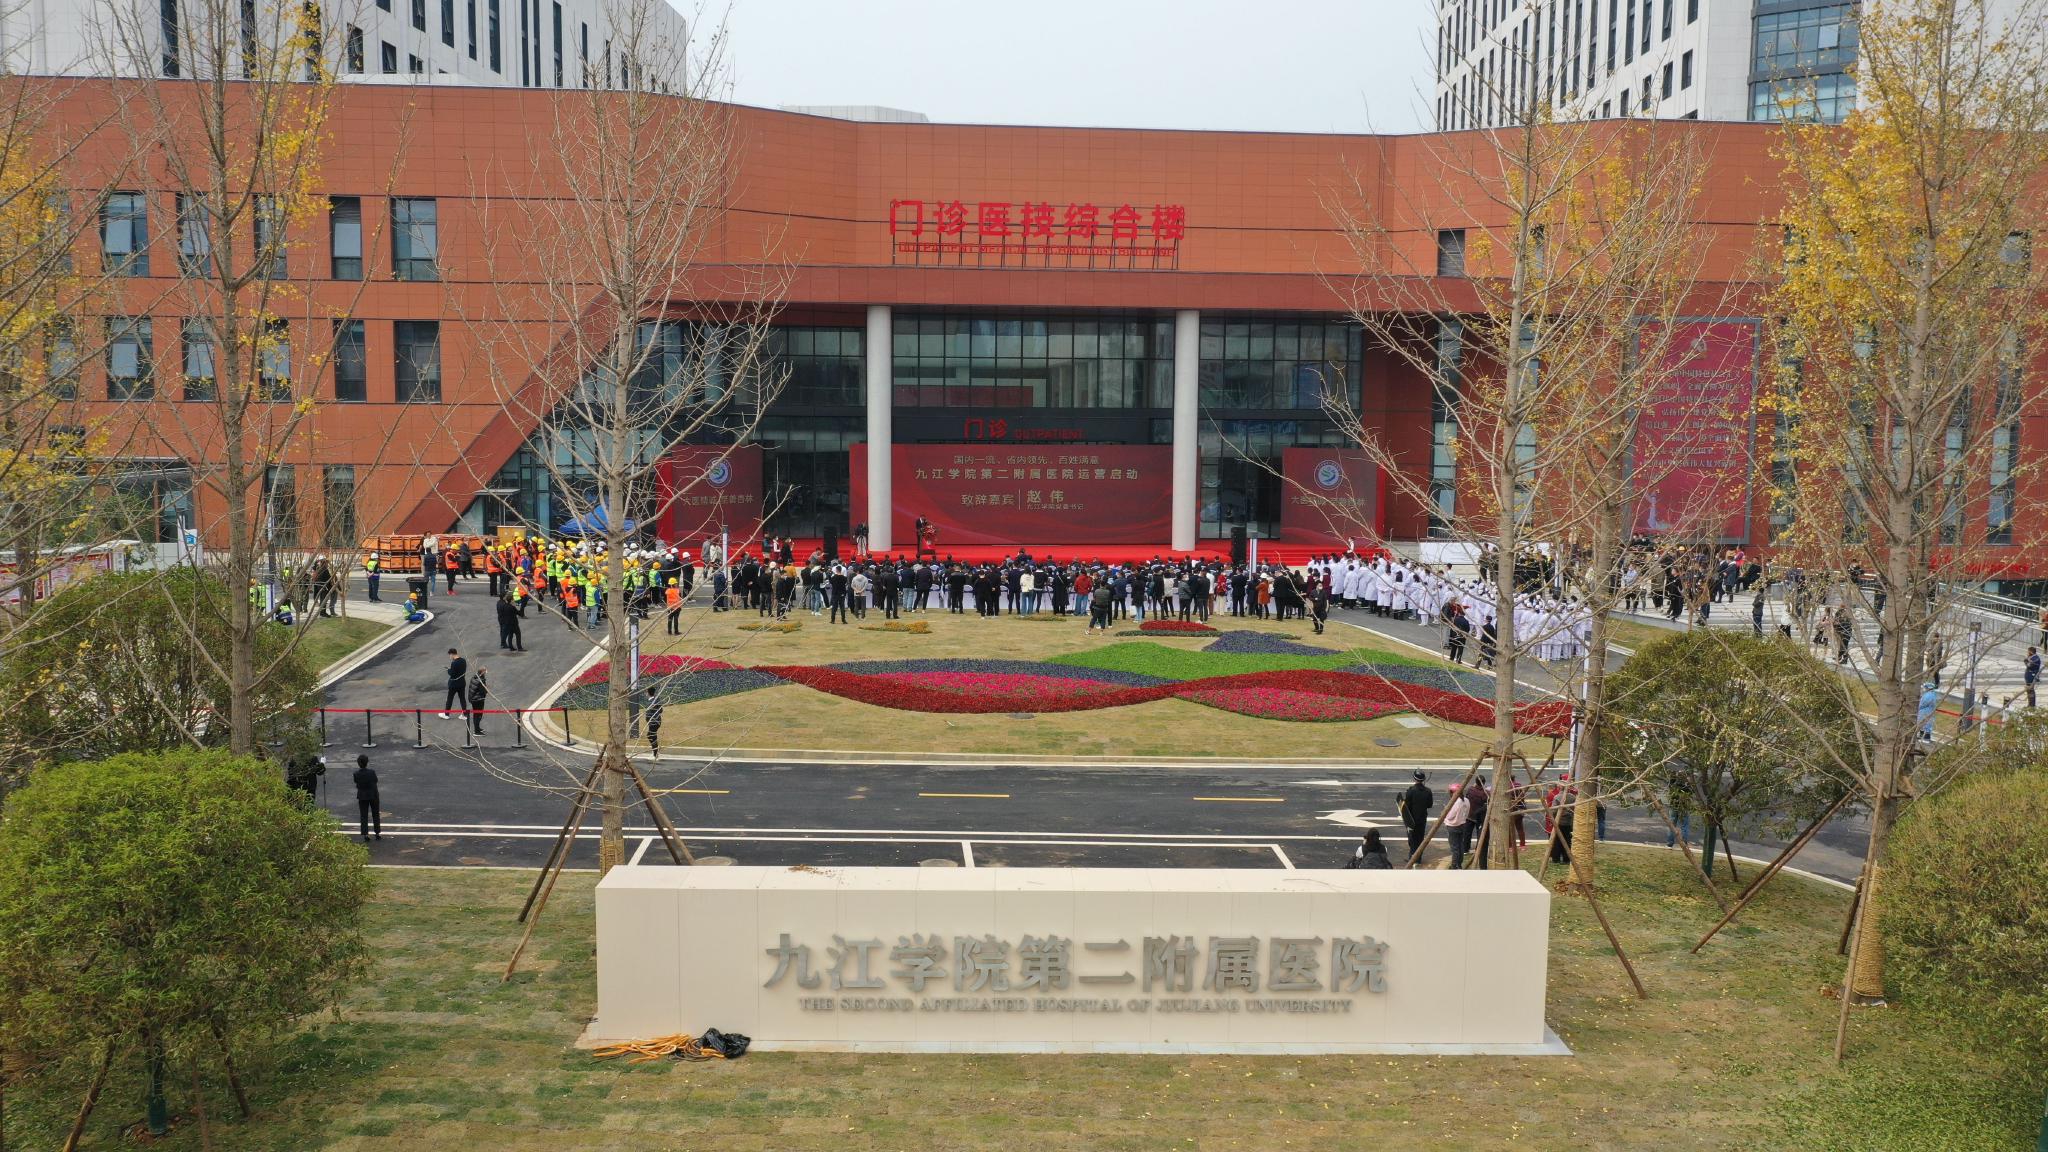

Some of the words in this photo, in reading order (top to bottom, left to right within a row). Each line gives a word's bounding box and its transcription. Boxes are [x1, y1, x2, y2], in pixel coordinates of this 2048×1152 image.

[889, 199, 1186, 240] 门诊医技综合楼
[963, 416, 1008, 440] 门诊
[915, 468, 1138, 480] 九江学院第二附属医院运营启动
[961, 494, 1015, 506] 致辞嘉宾
[762, 932, 1391, 994] 九江学院第二附属医院
[799, 998, 835, 1011] THE
[839, 998, 914, 1011] SECOND
[919, 998, 1029, 1011] AFFILIATED
[1033, 998, 1122, 1012] HOSPITAL
[1127, 999, 1151, 1012] OF
[1156, 999, 1240, 1012] JIUJIANG
[1245, 999, 1353, 1012] UNIVERSITY
